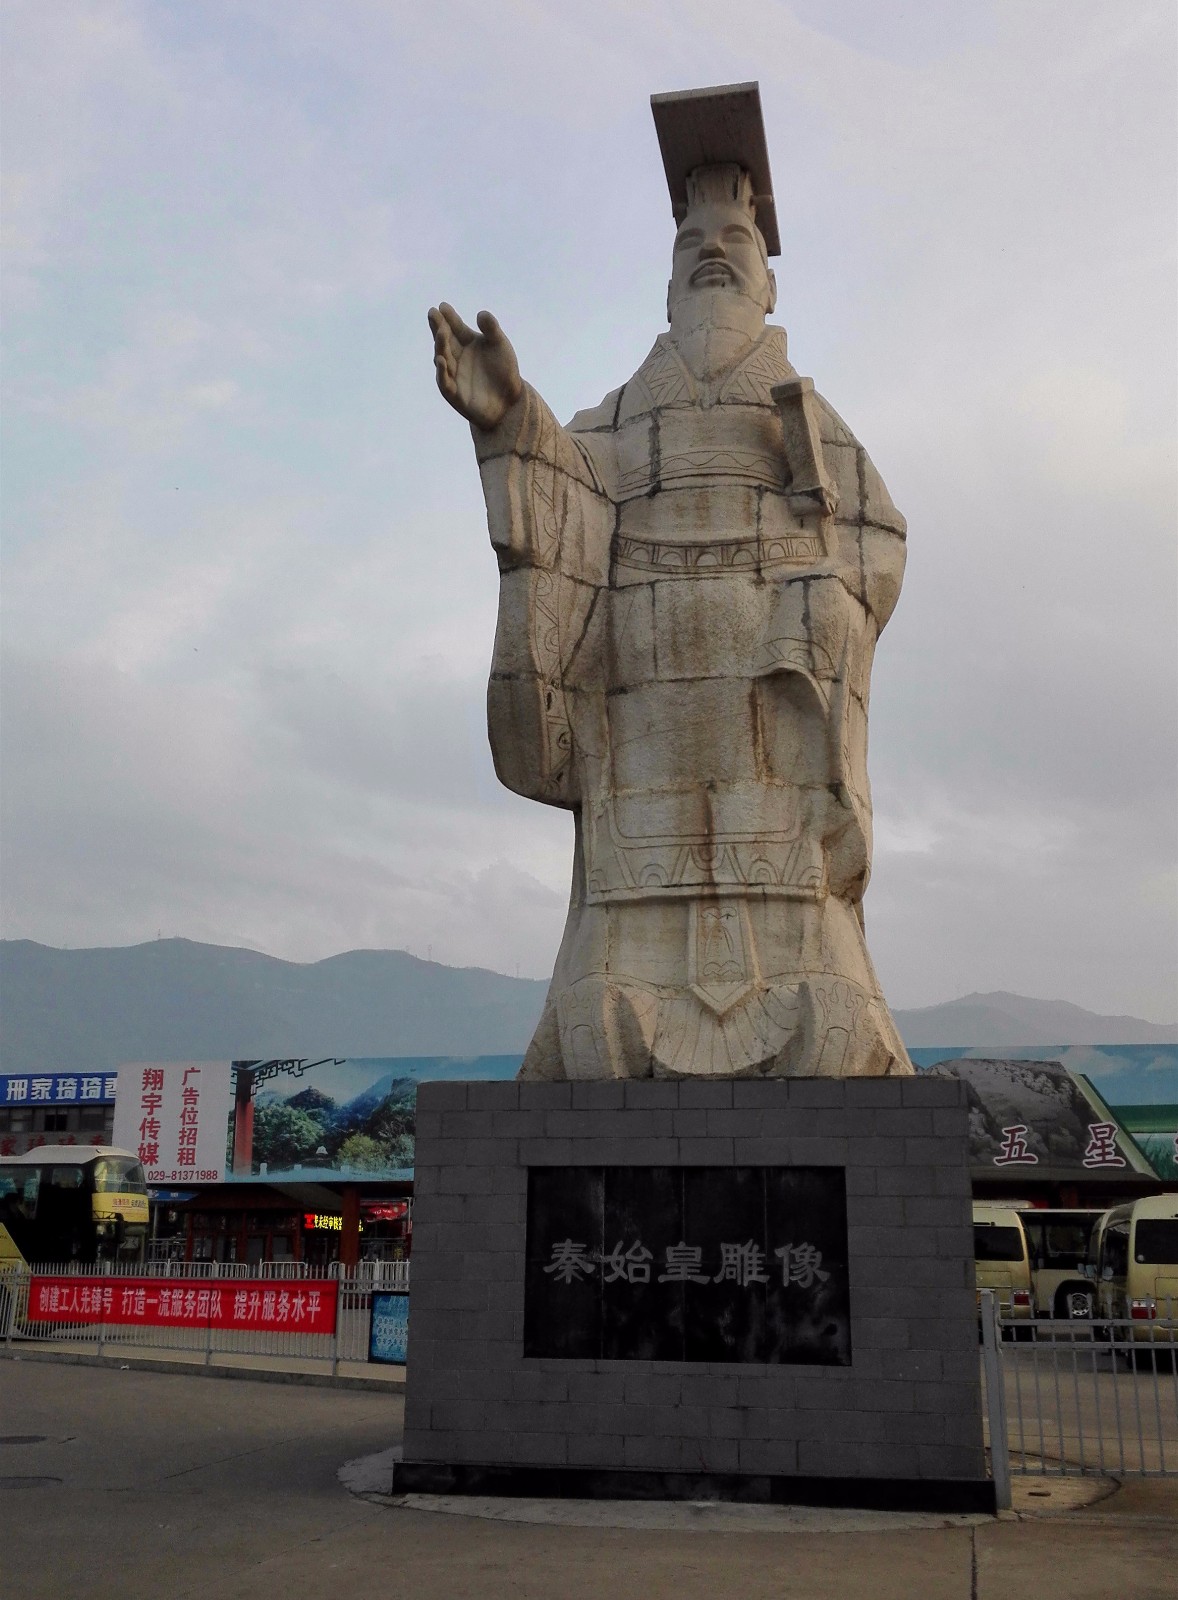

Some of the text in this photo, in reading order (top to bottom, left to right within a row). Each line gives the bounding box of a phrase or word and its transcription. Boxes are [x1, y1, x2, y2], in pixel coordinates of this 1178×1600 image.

[138, 1068, 164, 1166] 翔宇传媒
[177, 1067, 201, 1166] 广告位招租
[993, 1122, 1178, 1169] 五星
[147, 1170, 218, 1182] 029-81371988
[543, 1238, 831, 1289] 秦始皇雕像
[39, 1286, 322, 1324] 创建工人先锋号 打造一流服务团队 提升服务水平
